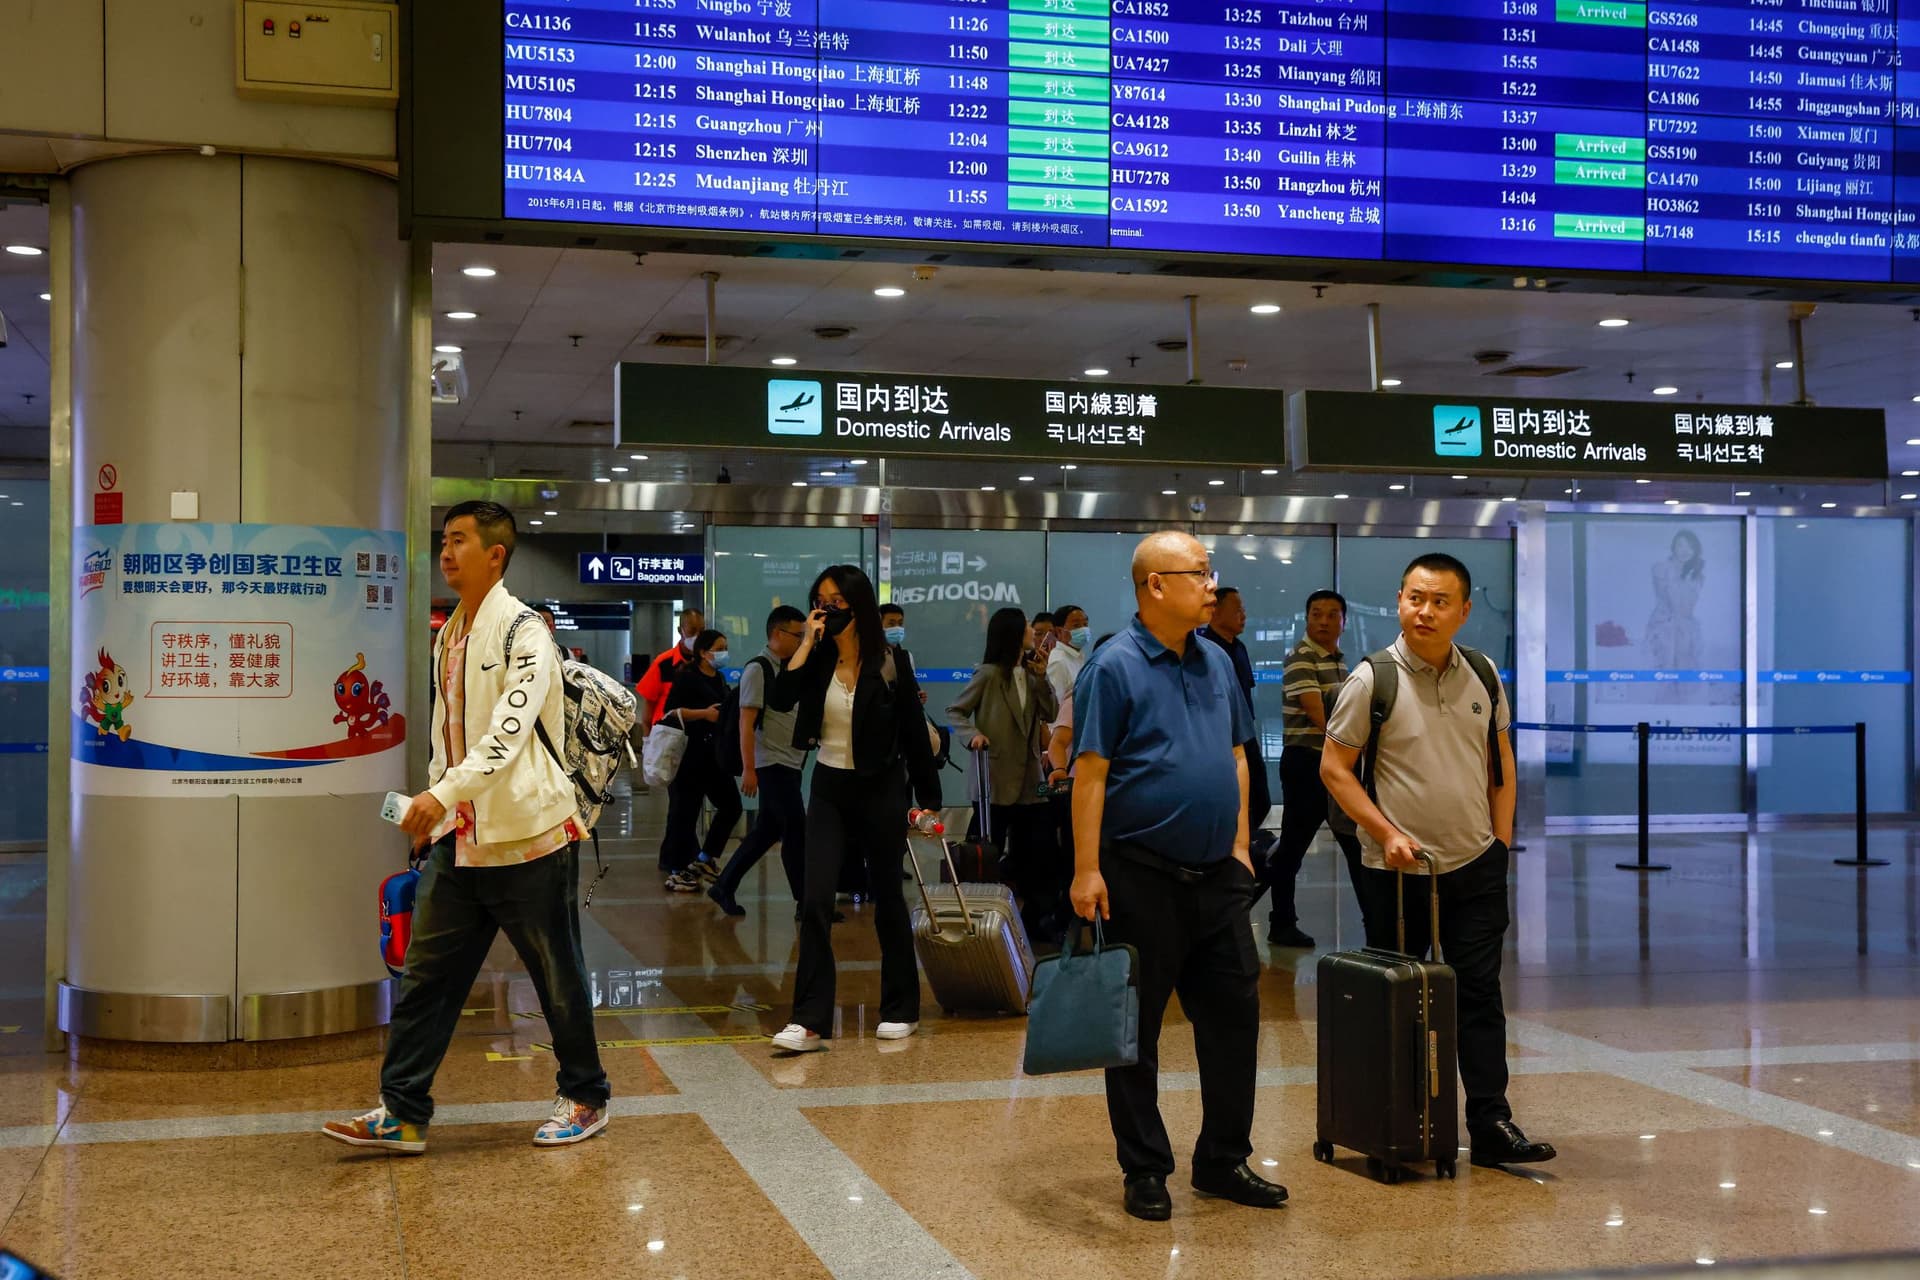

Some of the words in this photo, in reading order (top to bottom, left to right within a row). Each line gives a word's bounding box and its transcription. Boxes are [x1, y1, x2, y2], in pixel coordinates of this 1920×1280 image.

[697, 0, 751, 15] Ningbo
[757, 0, 791, 17] 宁波
[950, 16, 988, 31] 11:26
[1045, 22, 1076, 39] 到达
[1113, 0, 1168, 16] CA1852
[1226, 8, 1261, 23] 13:25
[1279, 11, 1332, 27] Taizhou
[1338, 13, 1367, 31] 台州
[1504, 28, 1535, 42] 13:51
[1504, 2, 1537, 15] 13:08
[1576, 5, 1626, 19] Arrived
[1649, 11, 1697, 26] GS5268
[1751, 18, 1782, 32] 14:45
[1799, 21, 1864, 39] Chongqing
[1871, 23, 1898, 40] 重庆
[506, 13, 571, 30] CA1136
[636, 23, 676, 38] 11:55
[696, 25, 771, 43] Wulanhot
[776, 29, 849, 50] 乌兰浩特
[950, 45, 987, 59] 11:50
[1045, 51, 1077, 69] 到达
[1113, 28, 1169, 43] CA1500
[1226, 36, 1261, 50] 13:25
[1280, 38, 1306, 52] Dali
[1312, 38, 1342, 55] 大理
[1504, 55, 1537, 69] 15:55
[1649, 38, 1699, 52] CA1458
[1751, 45, 1782, 58] 14:45
[1798, 47, 1867, 64] Guangyuan
[1872, 49, 1901, 66] 广元
[507, 44, 574, 62] MU5153
[635, 54, 676, 69] 12:00
[696, 56, 766, 76] Shanghai
[772, 61, 844, 82] Hongqiao
[851, 65, 920, 86] 上海虹桥
[950, 75, 987, 89] 11:48
[1045, 80, 1076, 97] 到达
[1113, 56, 1168, 72] UA7427
[1226, 64, 1261, 78] 13:25
[1279, 66, 1345, 86] Mianyang
[1351, 69, 1380, 85] 绵阳
[1503, 82, 1536, 96] 15:22
[1649, 64, 1699, 79] HU7622
[1751, 71, 1782, 84] 14:50
[1798, 72, 1845, 87] Jiamusi
[1850, 73, 1892, 91] 佳木斯
[507, 74, 575, 92] MU5105
[636, 84, 676, 99] 12:15
[696, 86, 766, 106] Shanghai
[772, 91, 844, 111] Hongqiao
[850, 94, 920, 114] 上海虹桥
[950, 104, 987, 118] 12:22
[1044, 108, 1076, 126] 到达
[1113, 85, 1165, 101] Y87614
[1226, 93, 1261, 107] 13:30
[1279, 95, 1340, 113] Shanghai
[1345, 99, 1396, 118] Pudong
[1401, 101, 1463, 120] 上海浦东
[1503, 110, 1537, 124] 13:37
[1648, 91, 1699, 105] CA1806
[1750, 97, 1781, 111] 14:55
[1797, 99, 1880, 117] Jinggangshan
[507, 105, 571, 122] HU7804
[636, 113, 676, 128] 12:15
[696, 116, 781, 135] Guangzhou
[787, 119, 822, 137] 广州
[950, 132, 987, 147] 12:04
[1045, 136, 1075, 153] 到达
[1113, 113, 1169, 129] CA4128
[1226, 120, 1261, 135] 13:35
[1280, 122, 1321, 137] Linzhi
[1326, 123, 1356, 140] 林芝
[1503, 137, 1536, 150] 13:00
[1576, 139, 1627, 153] Arrived
[1649, 119, 1697, 133] FU7292
[1750, 125, 1781, 138] 15:00
[1798, 126, 1845, 141] Xiamen
[1850, 128, 1877, 144] 厦门
[506, 135, 572, 152] HU7704
[635, 143, 676, 158] 12:15
[696, 145, 767, 162] Shenzhen
[772, 147, 807, 165] 深圳
[950, 161, 987, 175] 12:00
[1044, 165, 1075, 182] 到达
[1112, 141, 1168, 157] CA9612
[1226, 148, 1260, 162] 13:40
[1279, 150, 1319, 164] Guilin
[1325, 150, 1355, 168] 桂林
[1503, 164, 1536, 177] 13:29
[1576, 166, 1626, 180] Arrived
[1648, 145, 1696, 159] GS5190
[1750, 151, 1781, 164] 15:00
[1797, 153, 1848, 170] Guiyang
[1854, 153, 1880, 169] 贵阳
[507, 165, 585, 182] HU7184A
[635, 172, 675, 187] 12:25
[696, 174, 788, 196] Mudanjiang
[794, 177, 848, 196] 牡丹江
[949, 190, 987, 203] 11:55
[1043, 191, 1075, 209] 到达
[1112, 169, 1169, 185] HU7278
[1225, 176, 1260, 189] 13:50
[1279, 177, 1344, 195] Hangzhou
[1350, 179, 1380, 196] 杭州
[1503, 191, 1536, 204] 14:04
[1647, 172, 1698, 186] CA1470
[1749, 177, 1781, 190] 15:00
[1798, 178, 1841, 195] Lijiang
[1846, 179, 1873, 195] 丽江
[1112, 198, 1167, 213] CA1592
[1224, 204, 1260, 217] 13:50
[1278, 205, 1344, 224] Yancheng
[1350, 207, 1380, 224] 盐城
[1502, 218, 1535, 231] 13:16
[1574, 219, 1626, 233] Arrived
[1648, 198, 1699, 213] HO3862
[1749, 204, 1780, 216] 15:10
[1797, 205, 1852, 222] Shanghai
[1857, 207, 1915, 225] Hongqiao
[1111, 228, 1144, 236] terminal.
[1647, 225, 1693, 238] 8L7148
[1748, 230, 1780, 243] 15:15
[1796, 231, 1846, 247] chengdu
[1851, 234, 1885, 246] tianfu
[1890, 234, 1919, 249] 成都
[837, 383, 949, 414] 国内到达
[1046, 392, 1157, 417] 国内線到着
[837, 417, 930, 438] Domestic
[939, 421, 1011, 441] Arrivals
[1047, 424, 1145, 445] 국내선도착
[1493, 408, 1591, 436] 国内到达
[1675, 414, 1773, 436] 国内線到着
[1495, 440, 1576, 459] Domestic
[1584, 442, 1646, 461] Arrivals
[1677, 443, 1764, 463] 국내선도착
[123, 553, 342, 577] 朝阳区争创国家卫生区
[638, 558, 684, 570] 行李查询
[638, 572, 675, 583] Baggage
